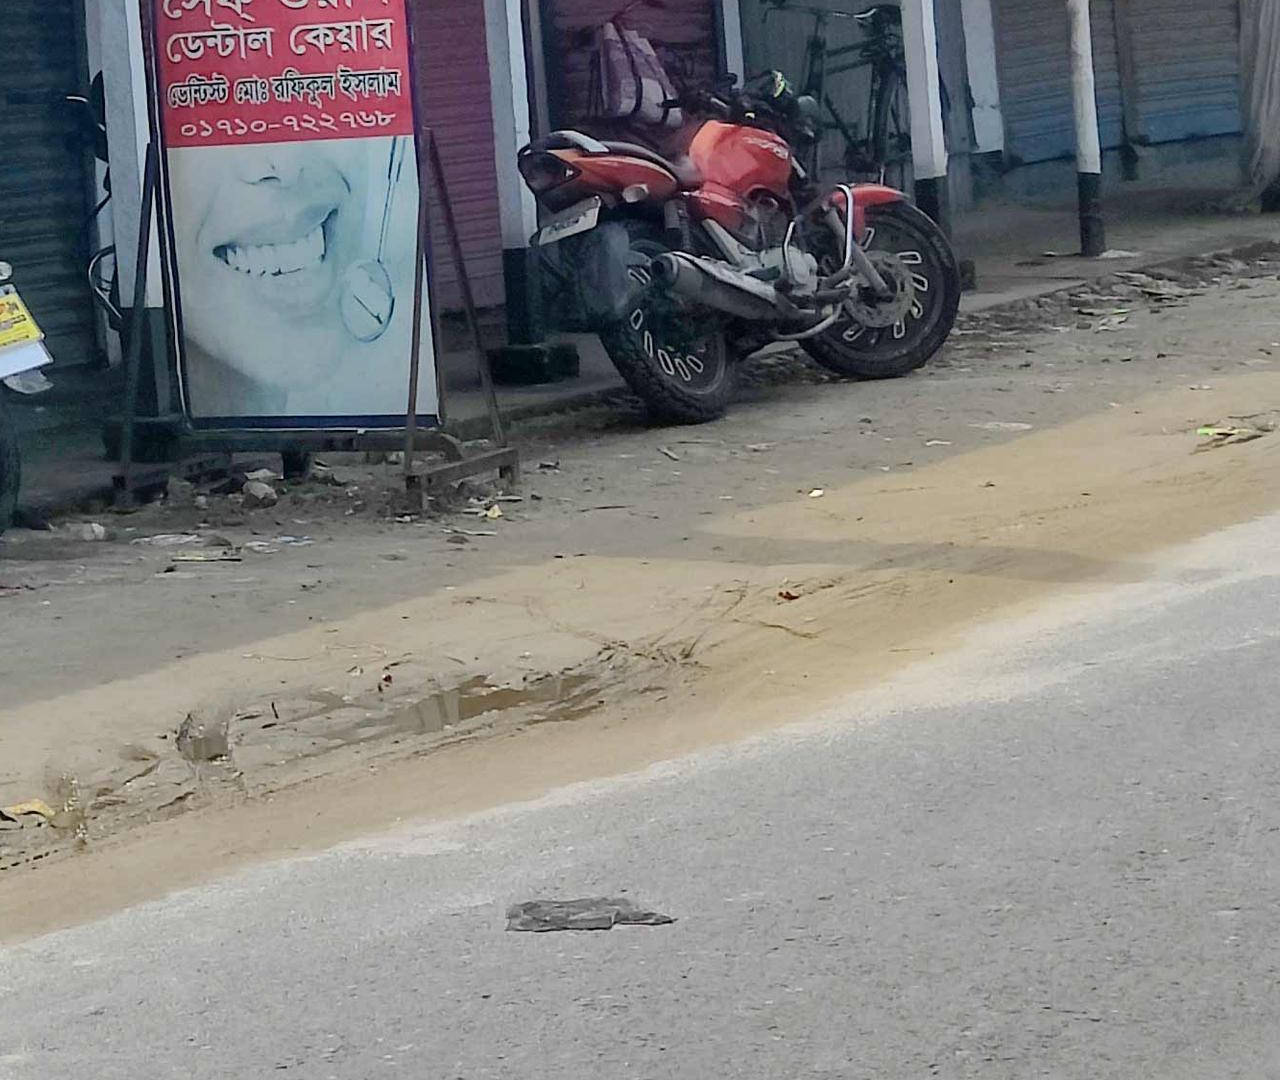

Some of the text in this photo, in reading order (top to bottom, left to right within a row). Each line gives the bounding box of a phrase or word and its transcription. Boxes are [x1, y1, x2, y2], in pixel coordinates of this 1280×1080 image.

[166, 16, 395, 63] ডেন্টাল কেয়ার
[167, 72, 229, 109] ডেন্টিস্ট
[234, 74, 270, 105] মোঃ
[338, 64, 402, 102] ইসলাম
[180, 109, 397, 138] ০১৭১০-৭২২৭৬৮
